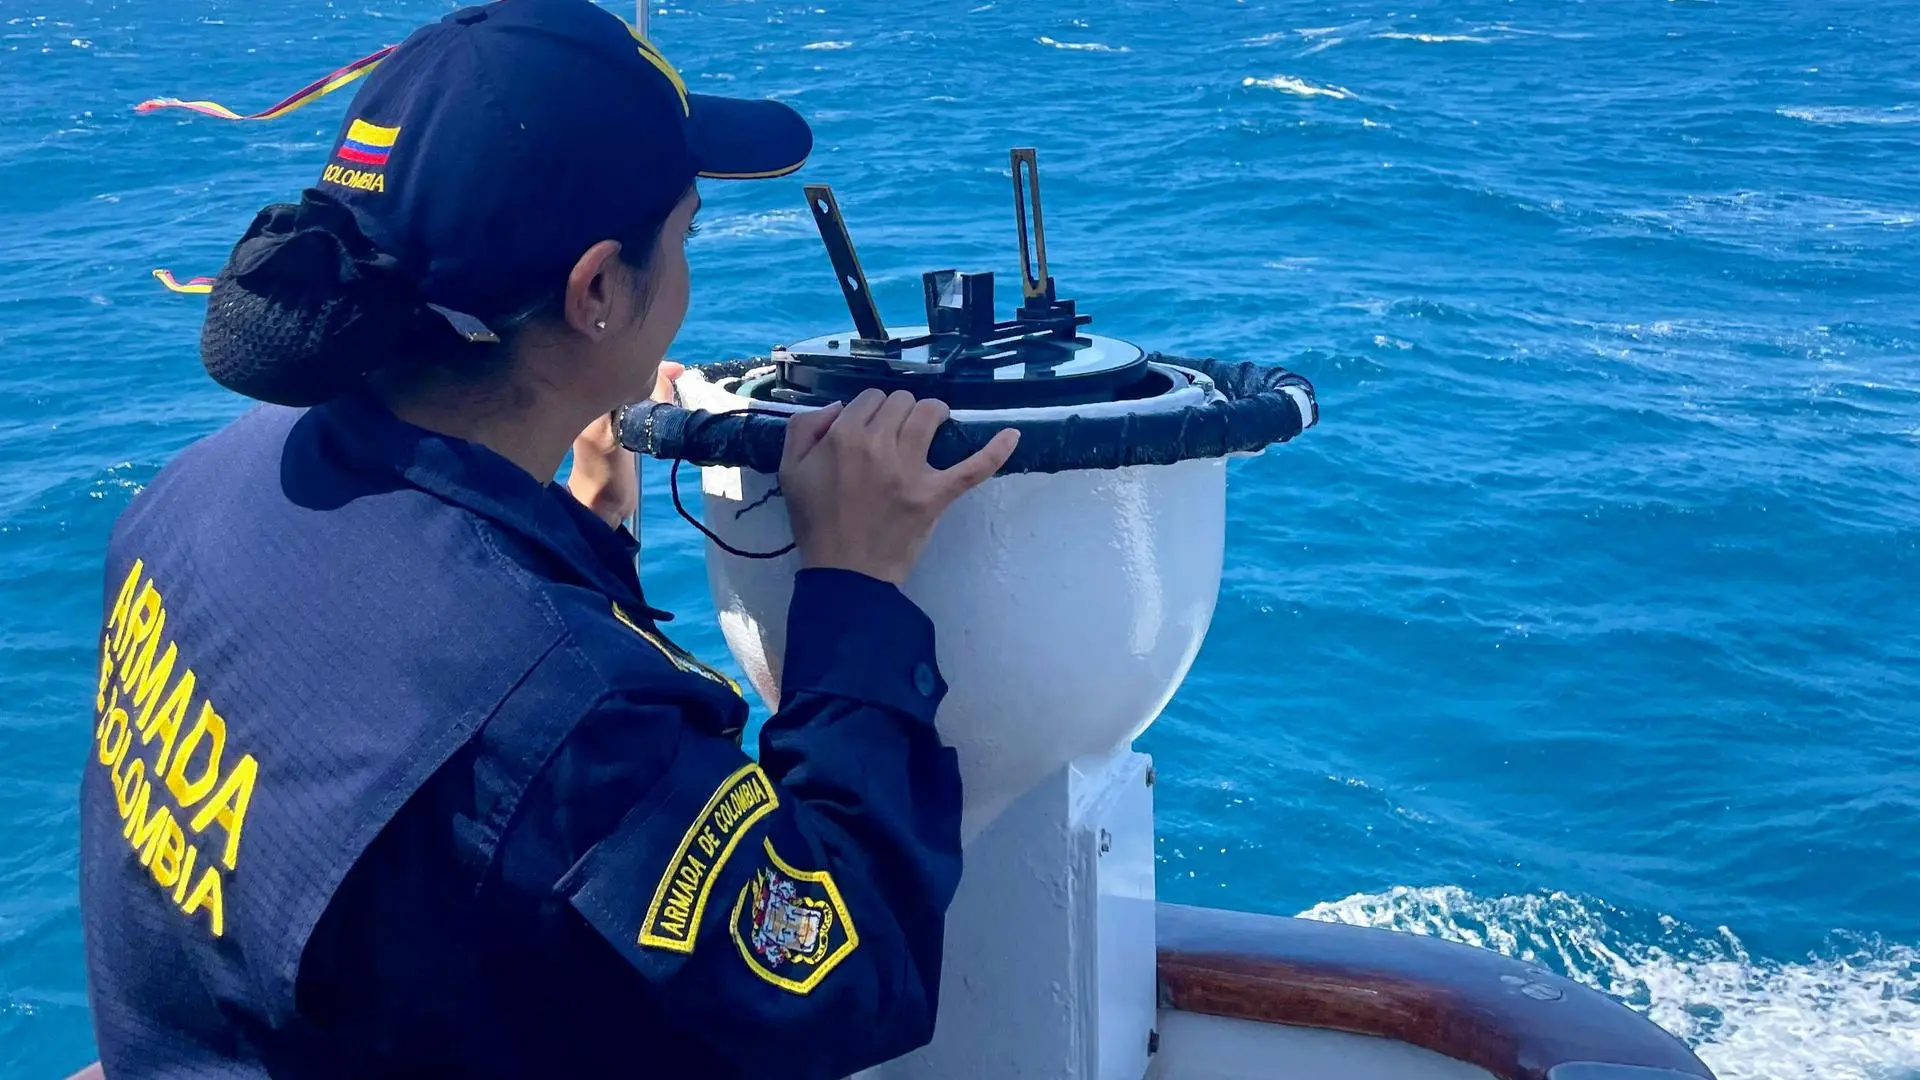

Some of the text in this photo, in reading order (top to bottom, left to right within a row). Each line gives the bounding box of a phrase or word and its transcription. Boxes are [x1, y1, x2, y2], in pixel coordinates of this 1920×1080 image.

[323, 163, 384, 193] COLOMBIA
[108, 558, 258, 871] ARMADA
[660, 777, 767, 938] ARMADA DE COLOMBIA
